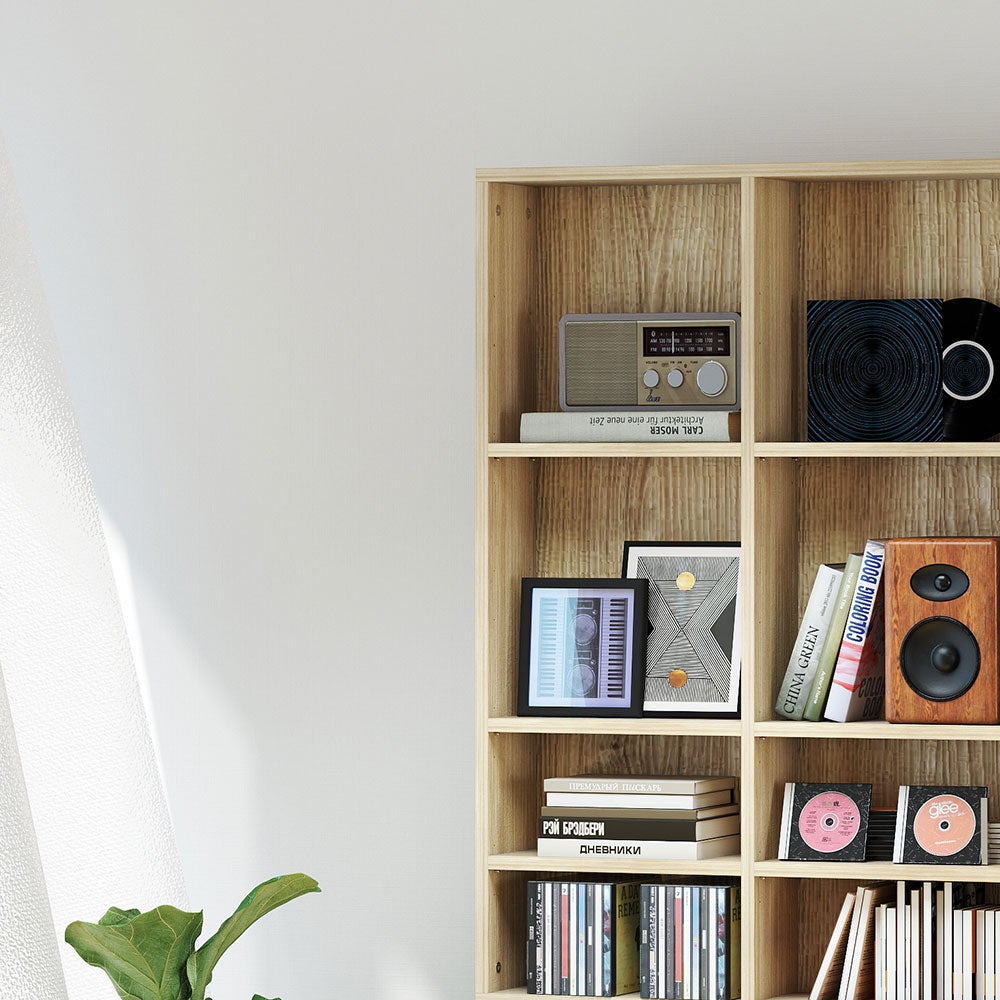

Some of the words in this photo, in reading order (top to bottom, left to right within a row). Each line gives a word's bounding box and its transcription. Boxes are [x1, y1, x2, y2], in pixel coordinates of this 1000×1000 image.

[590, 416, 604, 426] Zeit
[628, 416, 645, 426] eine
[646, 416, 658, 426] für
[660, 416, 704, 426] Architektur
[650, 426, 679, 435] MOSER
[684, 426, 704, 435] CARL
[860, 551, 884, 586] BOOK
[846, 586, 875, 643] COLORING
[783, 673, 806, 714] CHINA
[798, 626, 820, 669] GREEN
[928, 802, 959, 819] glee
[542, 818, 560, 836] РЭЙ
[562, 821, 605, 836] БРЭДБЕРИ
[580, 844, 642, 855] ДНЕВНИКИ
[618, 901, 640, 918] REME
